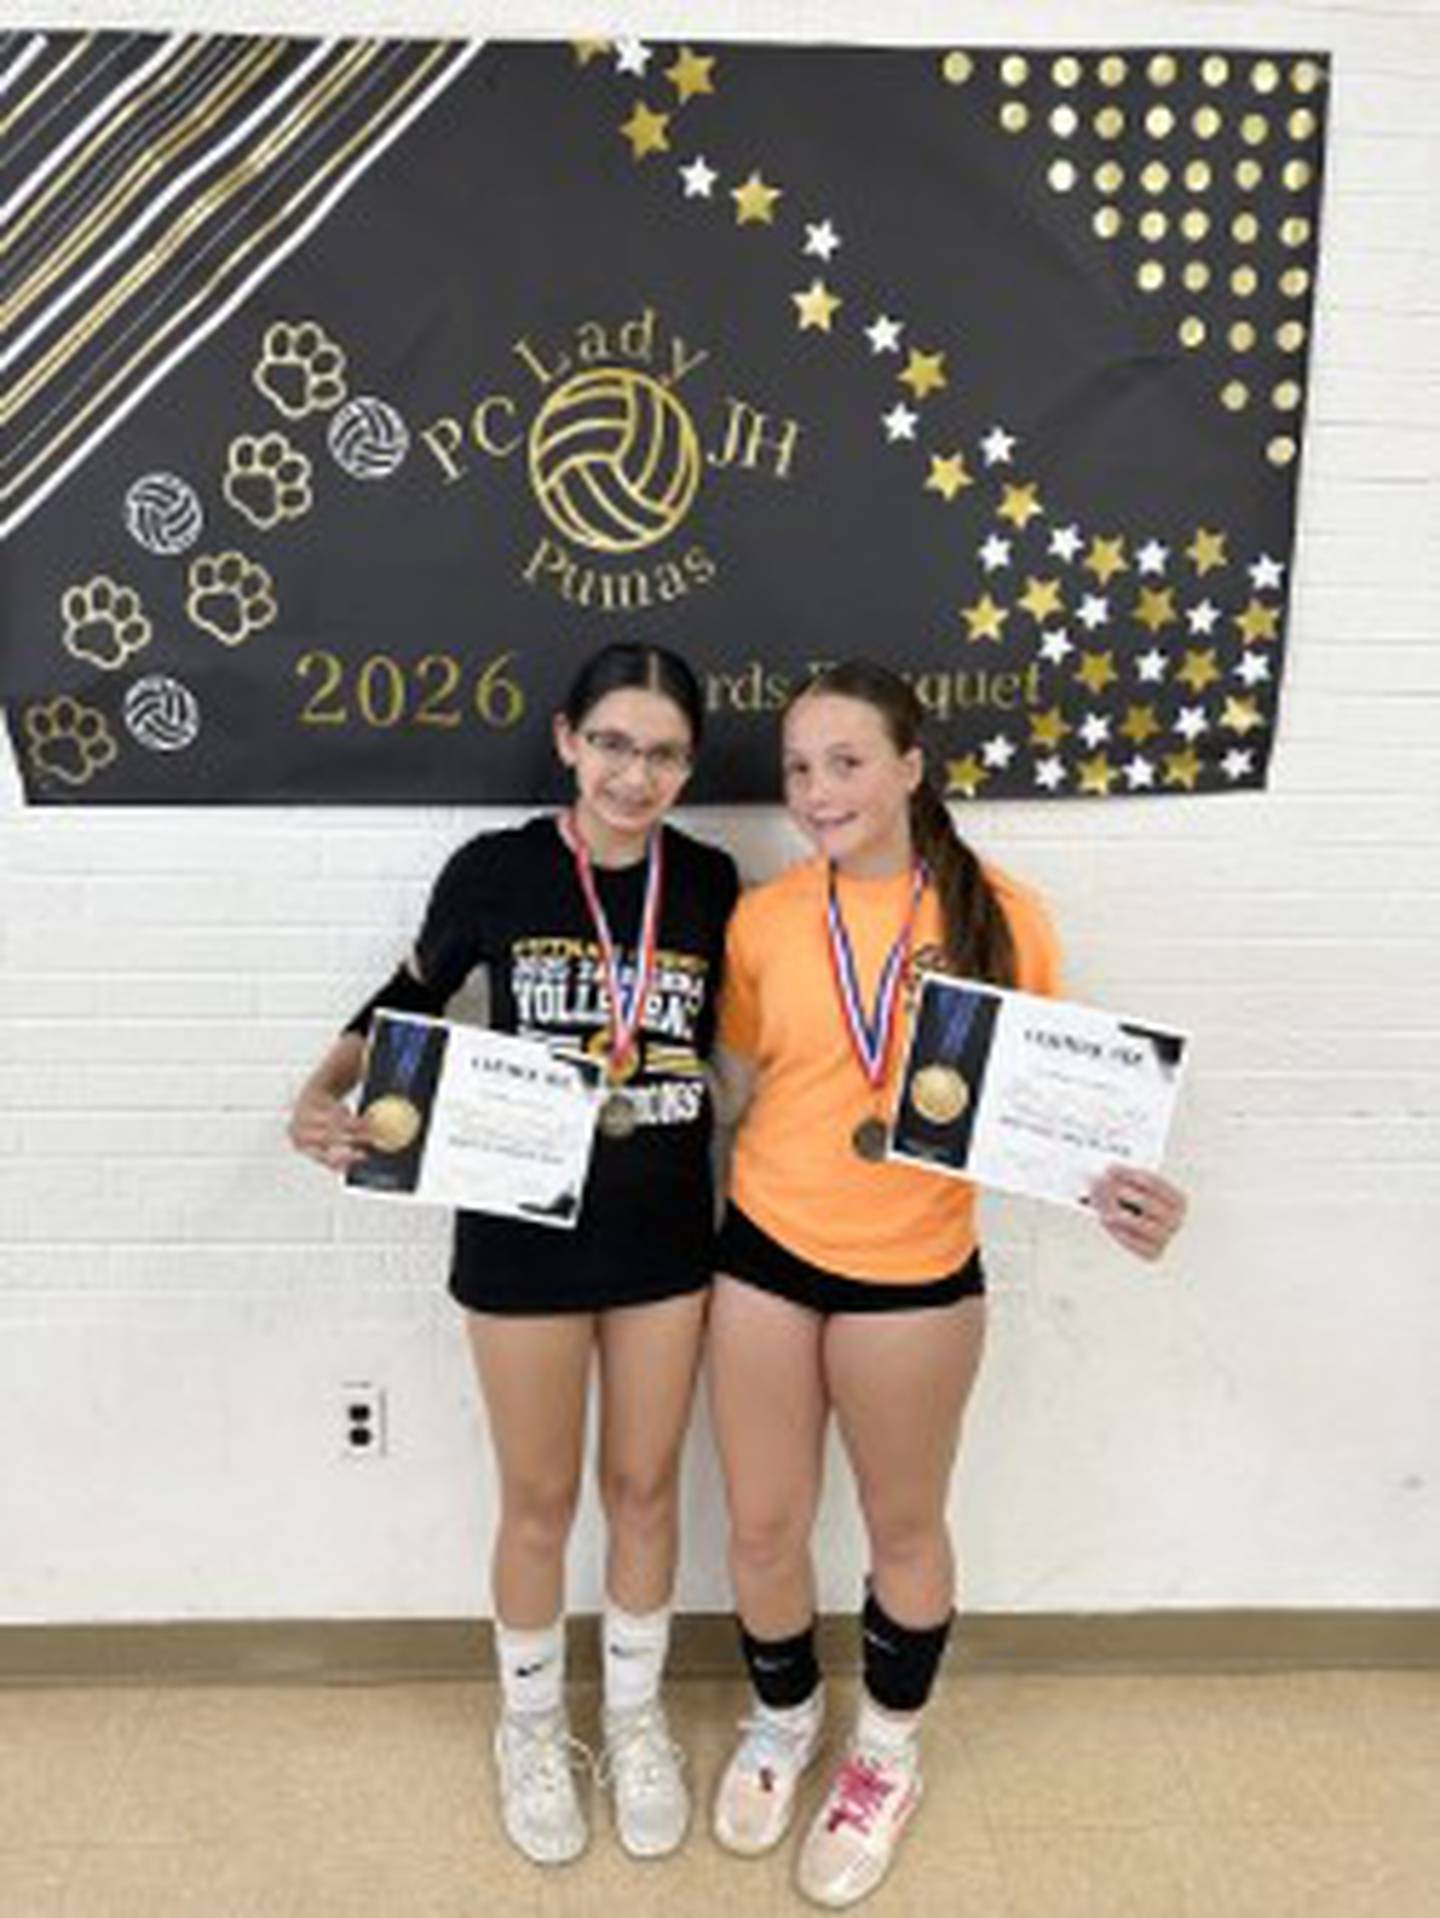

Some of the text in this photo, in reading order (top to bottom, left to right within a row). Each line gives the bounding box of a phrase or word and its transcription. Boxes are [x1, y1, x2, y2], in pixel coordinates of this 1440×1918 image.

[420, 307, 799, 481] PC Lady JH
[521, 537, 717, 611] Pumas
[296, 649, 525, 729] 2026
